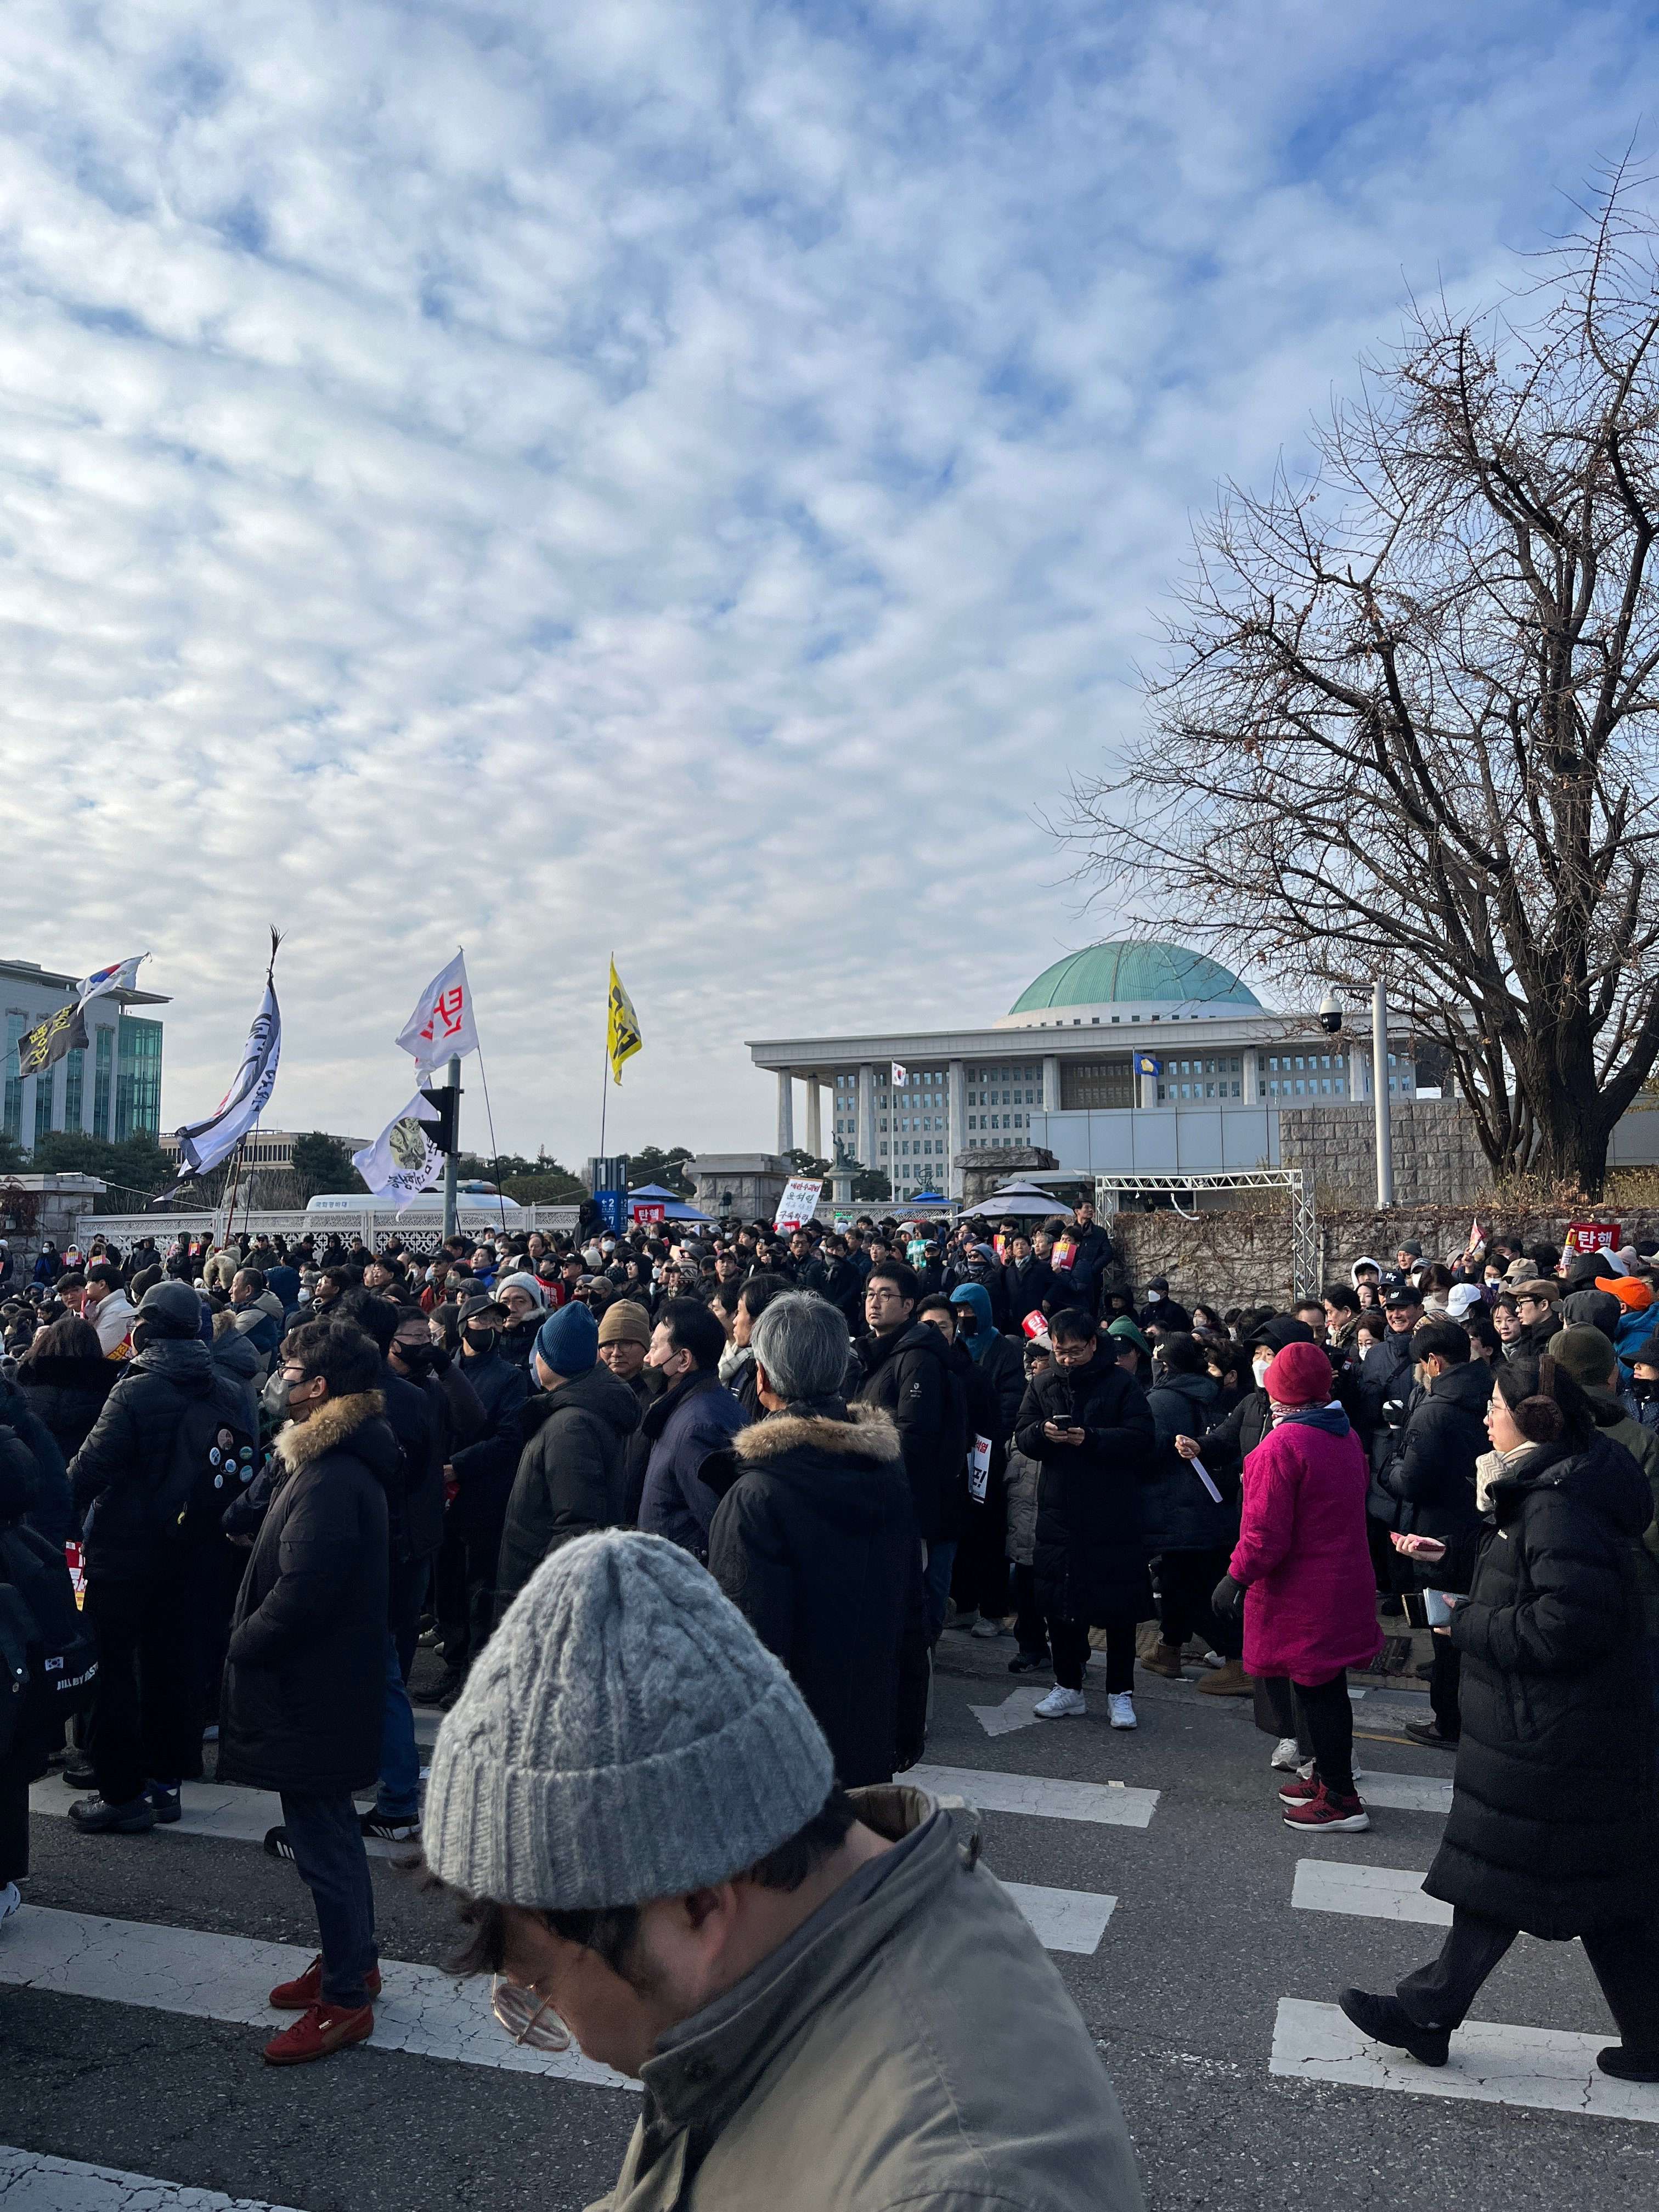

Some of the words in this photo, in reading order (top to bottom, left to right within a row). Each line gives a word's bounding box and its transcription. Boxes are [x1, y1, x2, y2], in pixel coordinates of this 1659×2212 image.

[599, 1163, 606, 1185] 1
[619, 1164, 625, 1185] 1
[608, 1198, 614, 1207] 2
[608, 1216, 614, 1225] 7
[639, 1208, 659, 1221] 탄핵
[1578, 1231, 1612, 1249] 탄핵
[1385, 1272, 1397, 1282] NY
[57, 1678, 72, 1690] JILL
